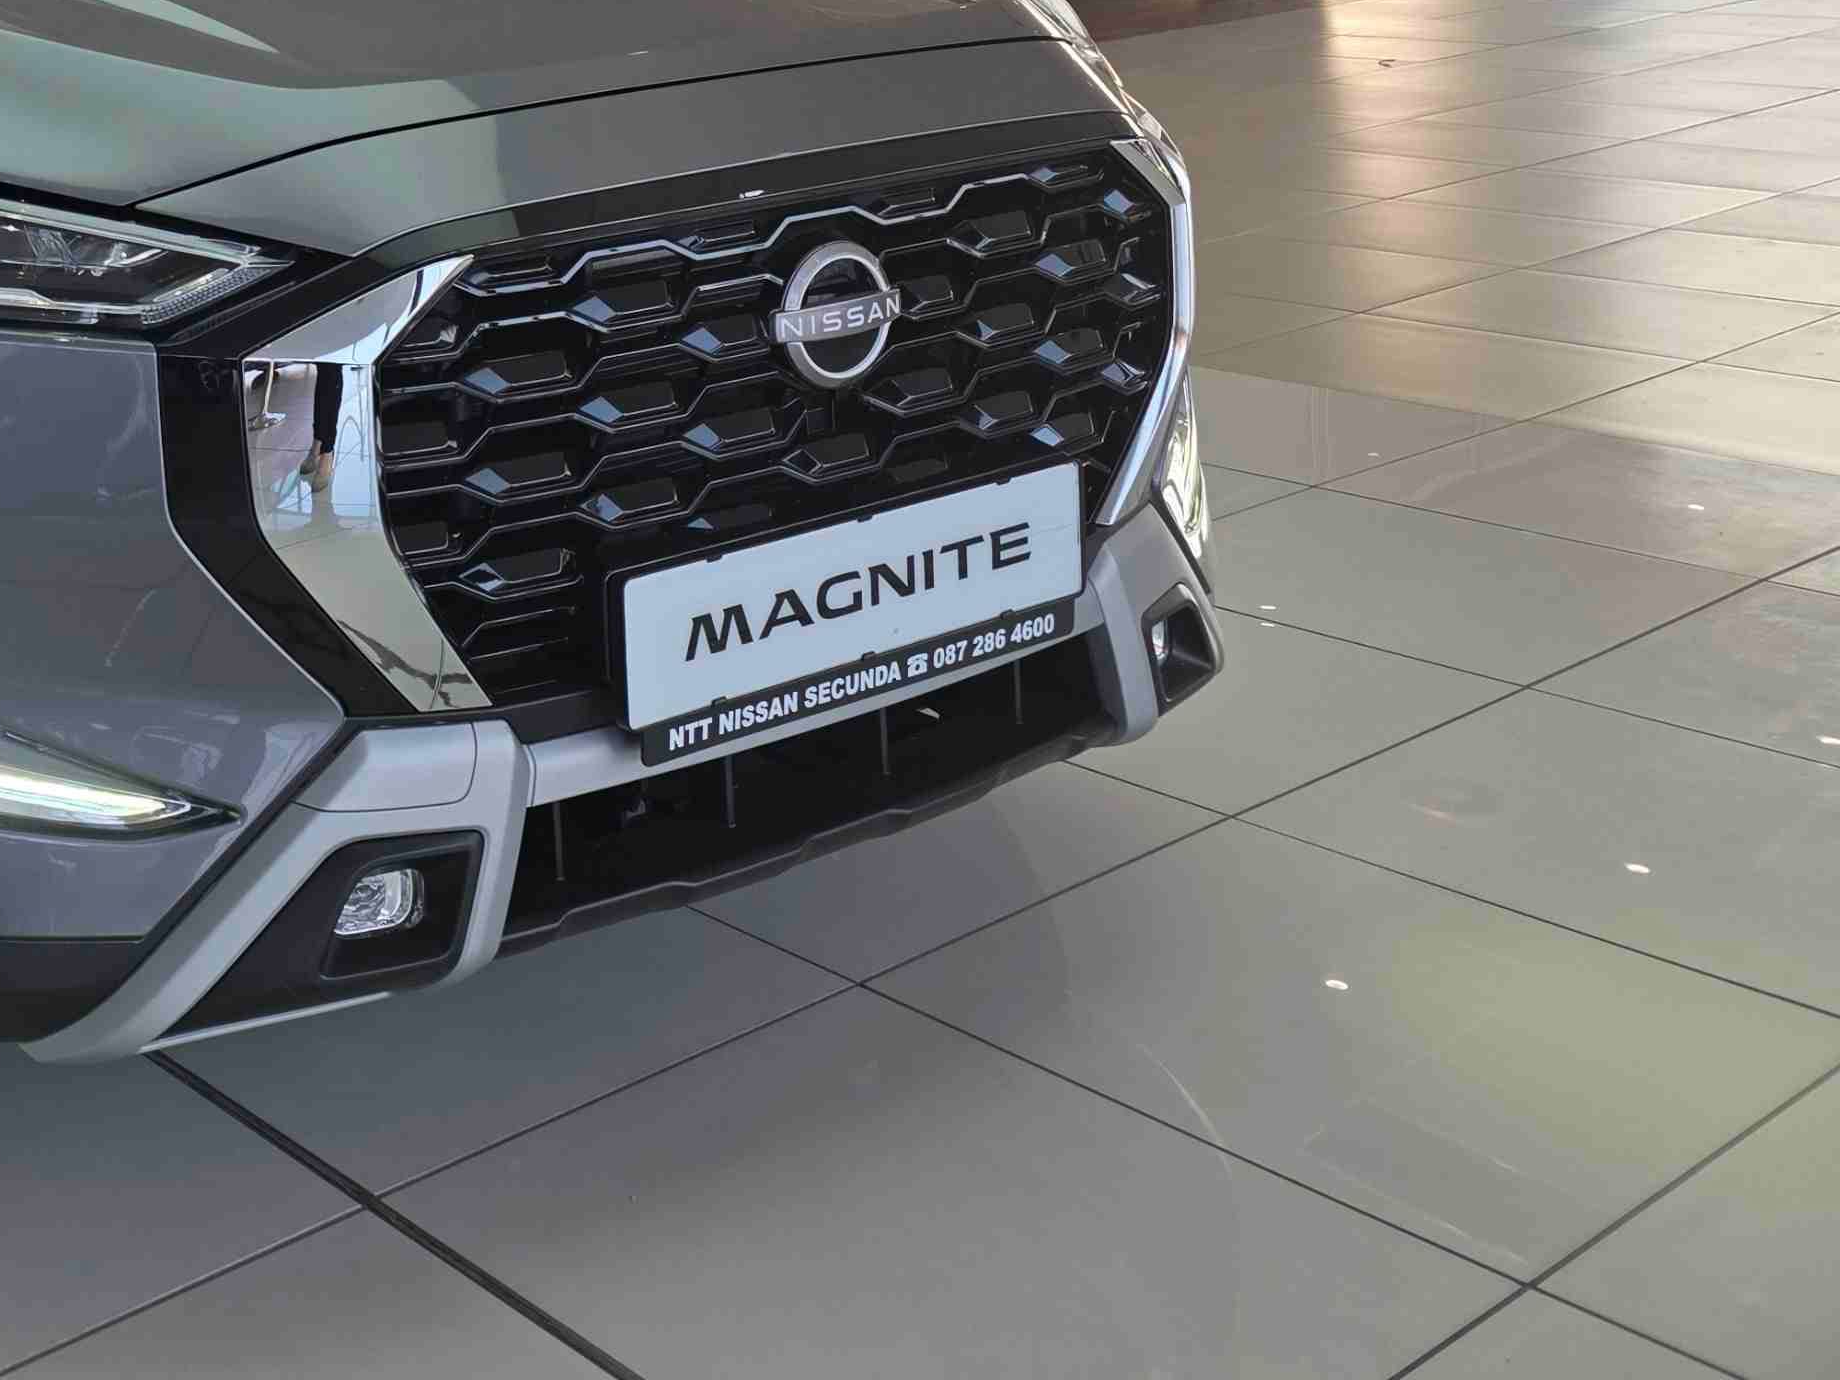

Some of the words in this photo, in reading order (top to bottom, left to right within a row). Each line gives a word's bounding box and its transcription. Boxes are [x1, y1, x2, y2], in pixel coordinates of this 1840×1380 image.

[780, 292, 900, 339] NISSAN
[684, 521, 1032, 662] MAGNITE
[668, 717, 713, 751] NTT
[718, 691, 799, 736] NISSAN
[803, 660, 902, 709] SECUNDA
[933, 640, 968, 669] 087
[971, 628, 1007, 658] 286
[1010, 612, 1056, 644] 4600
